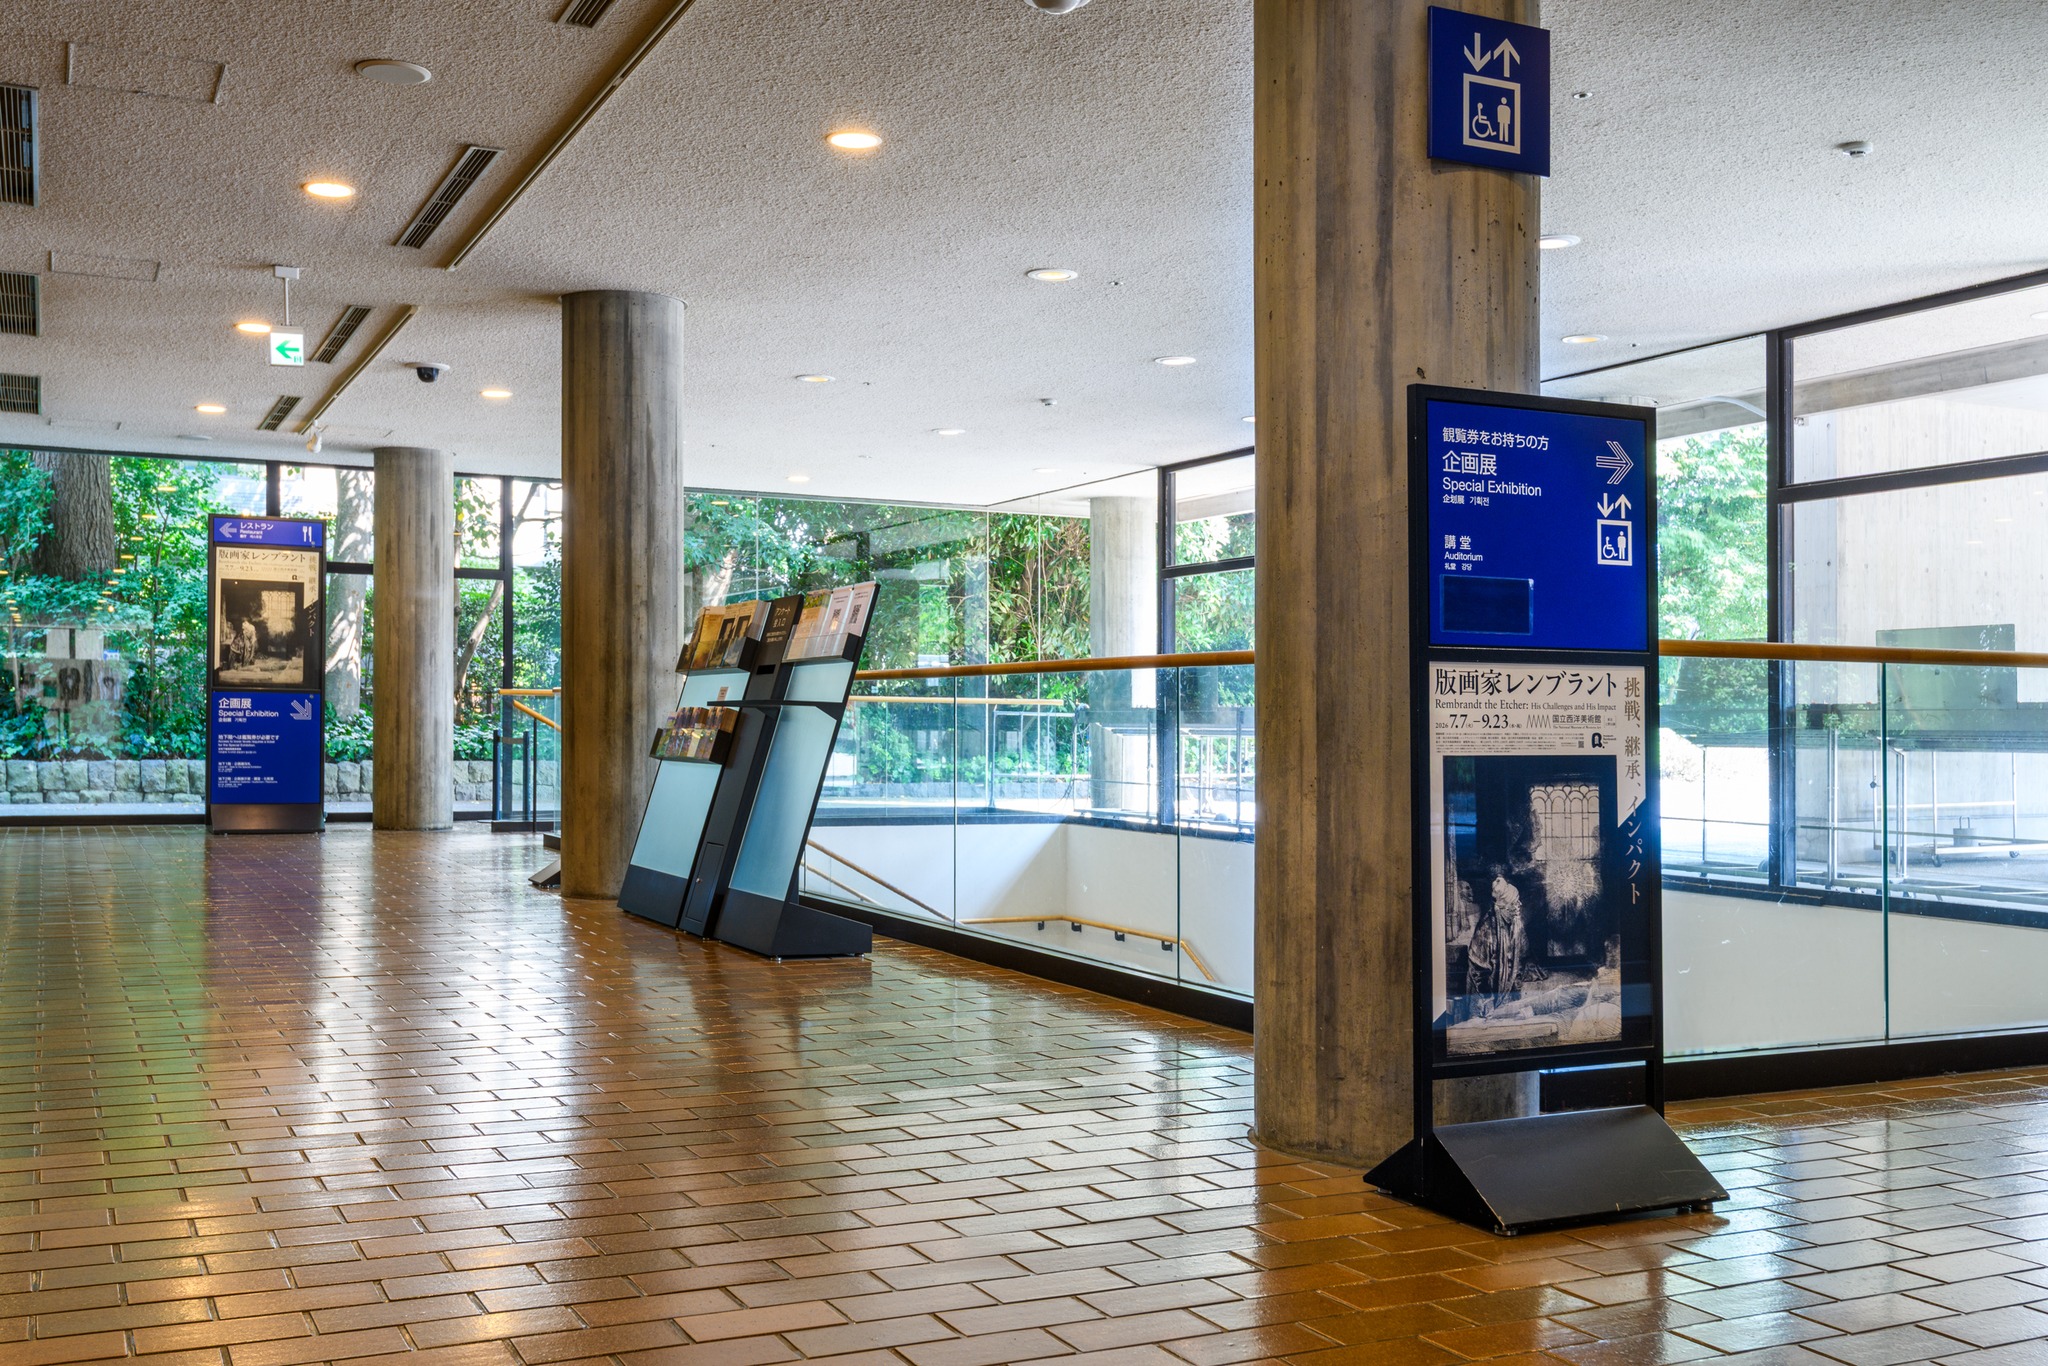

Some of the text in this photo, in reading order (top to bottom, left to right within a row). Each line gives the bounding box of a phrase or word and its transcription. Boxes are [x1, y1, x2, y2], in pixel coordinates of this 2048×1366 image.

[1442, 426, 1550, 451] 観覧券をお持ちの方
[1442, 450, 1497, 476] 企画展
[1442, 477, 1542, 497] Special Exhibition
[240, 521, 274, 531] レストラン
[218, 549, 306, 562] 版画家レンブラント
[1444, 551, 1483, 562] Auditorium
[1434, 668, 1617, 697] 版画家レンブラント
[219, 697, 251, 709] 企画展
[1435, 698, 1617, 712] Rembrandt the Etcher: His Challenges and His Impact
[218, 709, 244, 717] Special
[1552, 714, 1602, 724] 国立西洋美術館
